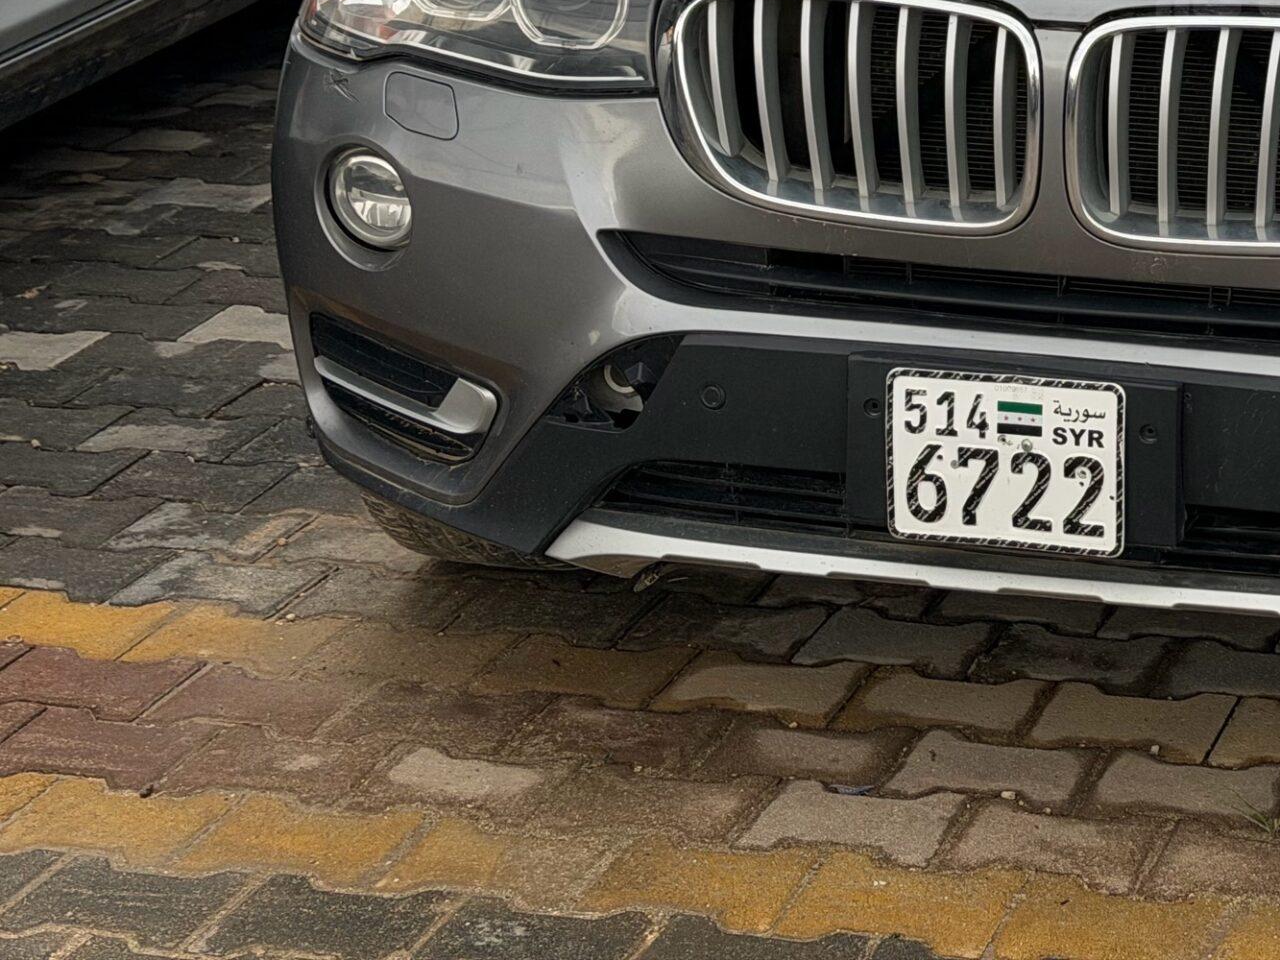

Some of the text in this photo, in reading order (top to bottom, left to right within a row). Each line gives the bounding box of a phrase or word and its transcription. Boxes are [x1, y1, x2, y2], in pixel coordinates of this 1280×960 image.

[904, 388, 989, 438] 514
[1052, 399, 1106, 423] سورية
[1052, 426, 1105, 448] SYR
[905, 443, 1105, 538] 6722
